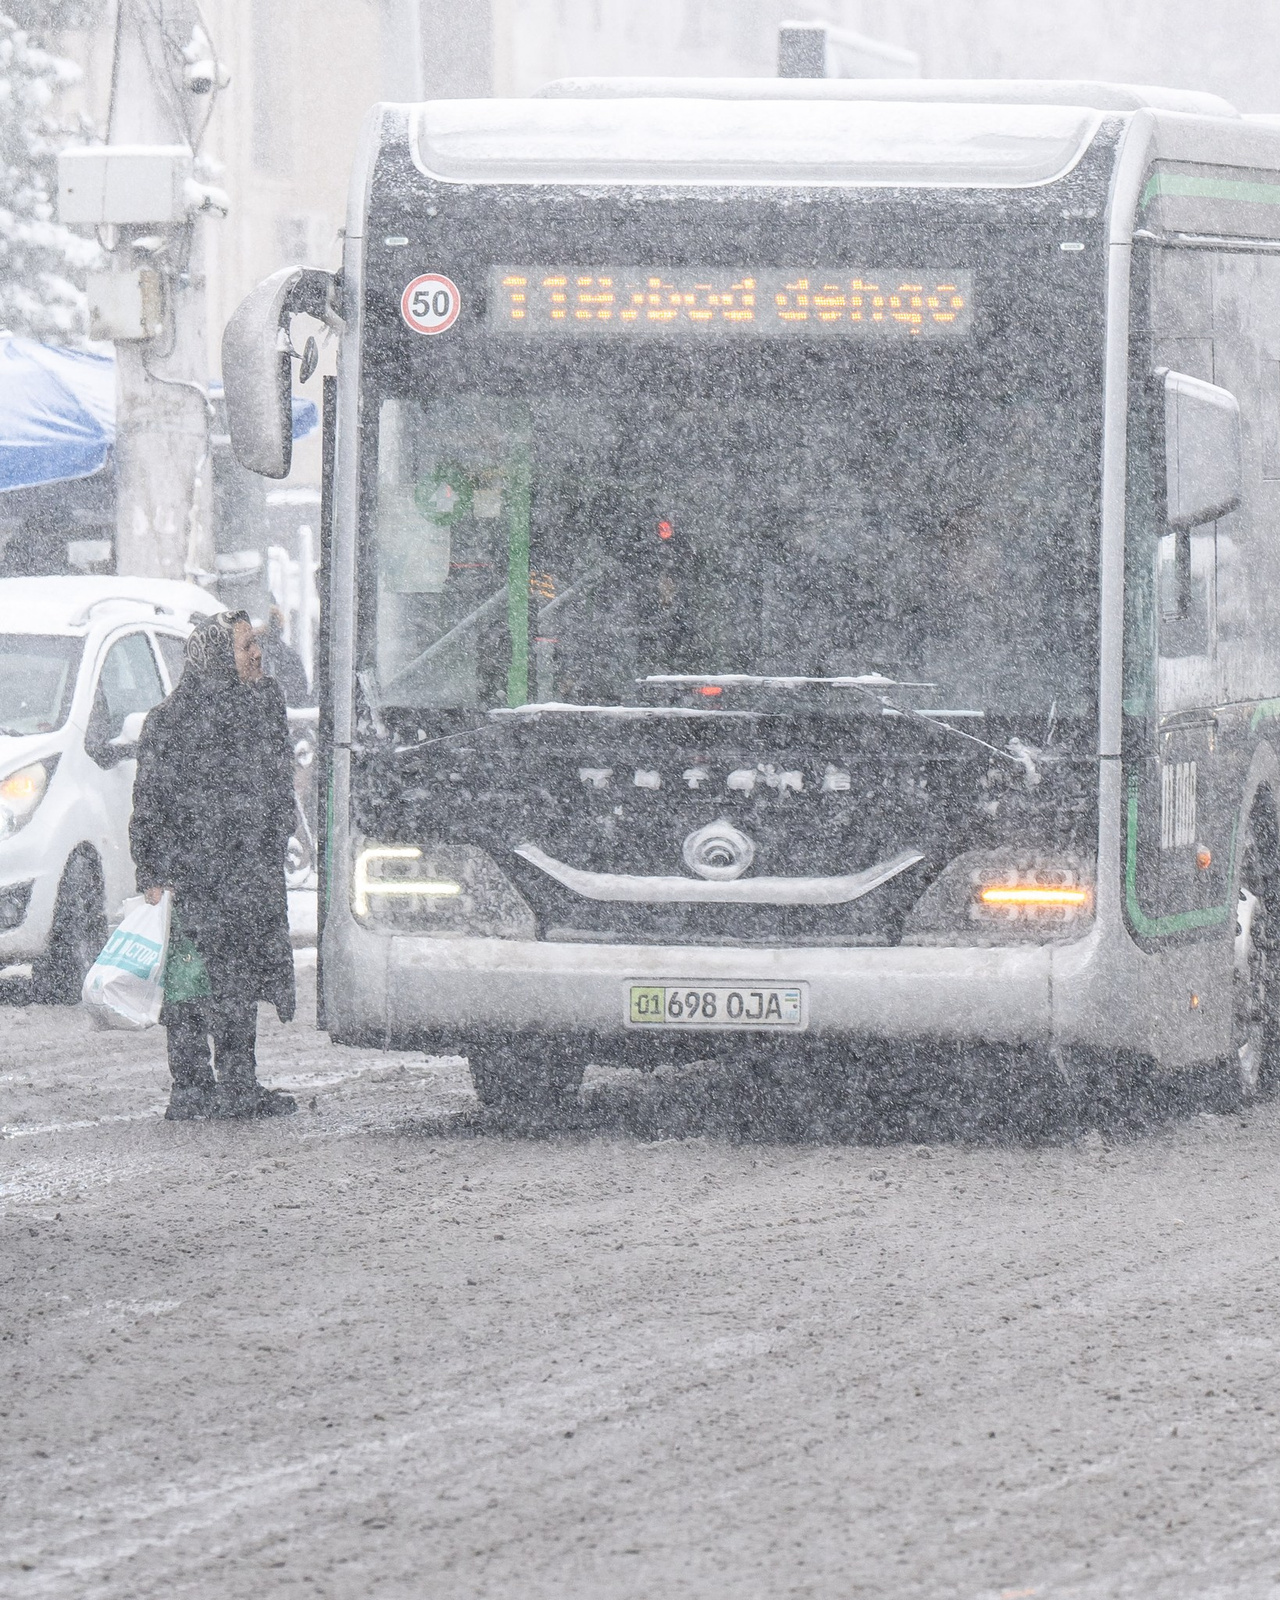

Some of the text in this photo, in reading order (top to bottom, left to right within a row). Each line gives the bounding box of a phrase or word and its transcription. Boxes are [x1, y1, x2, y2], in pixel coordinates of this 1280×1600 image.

[412, 290, 450, 318] 50
[637, 994, 662, 1015] 01
[668, 991, 717, 1018] 698
[726, 991, 783, 1019] OJA
